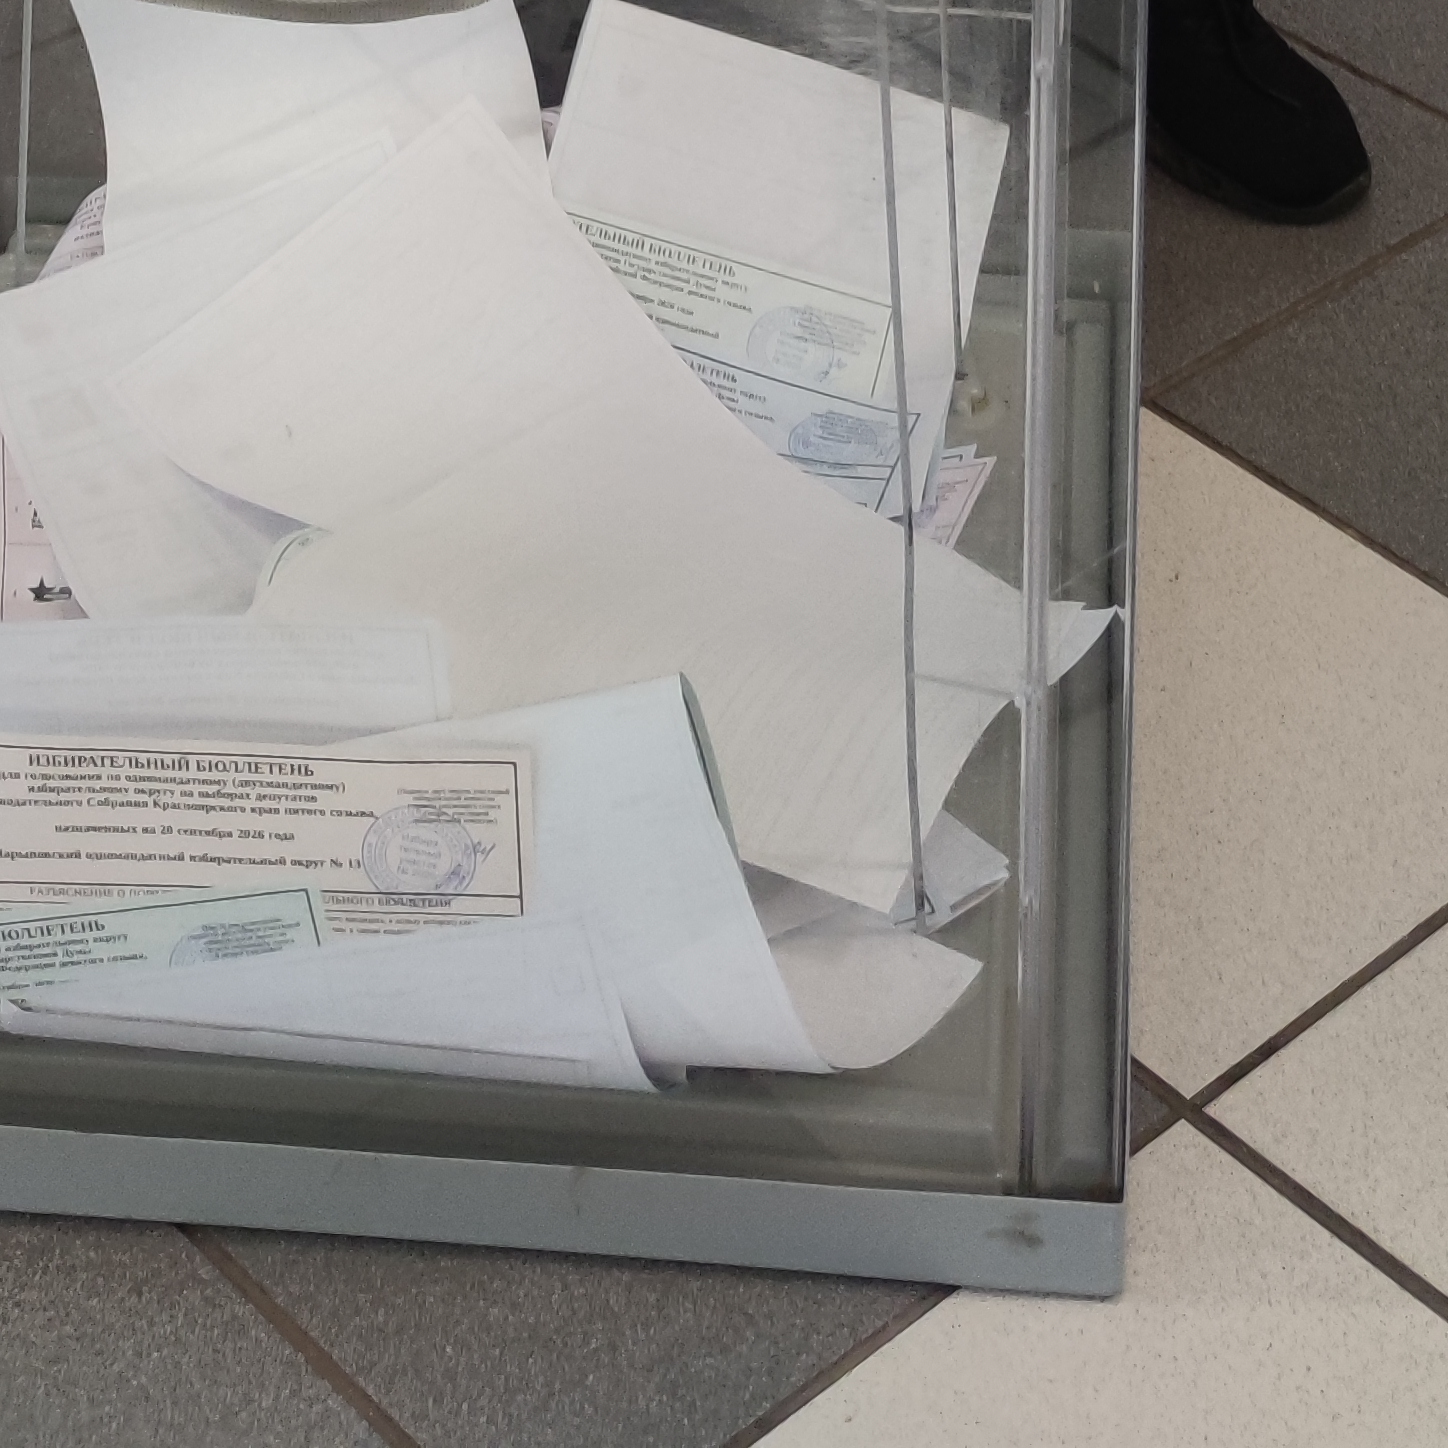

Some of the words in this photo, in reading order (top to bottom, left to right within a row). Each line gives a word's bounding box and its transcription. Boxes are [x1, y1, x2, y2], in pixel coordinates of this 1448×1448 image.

[28, 753, 190, 772] ИЗБИРАТЕЛЬНЫЙ
[196, 759, 315, 777] БЮЛЛЕТЕНЬ
[237, 829, 265, 840] 2026
